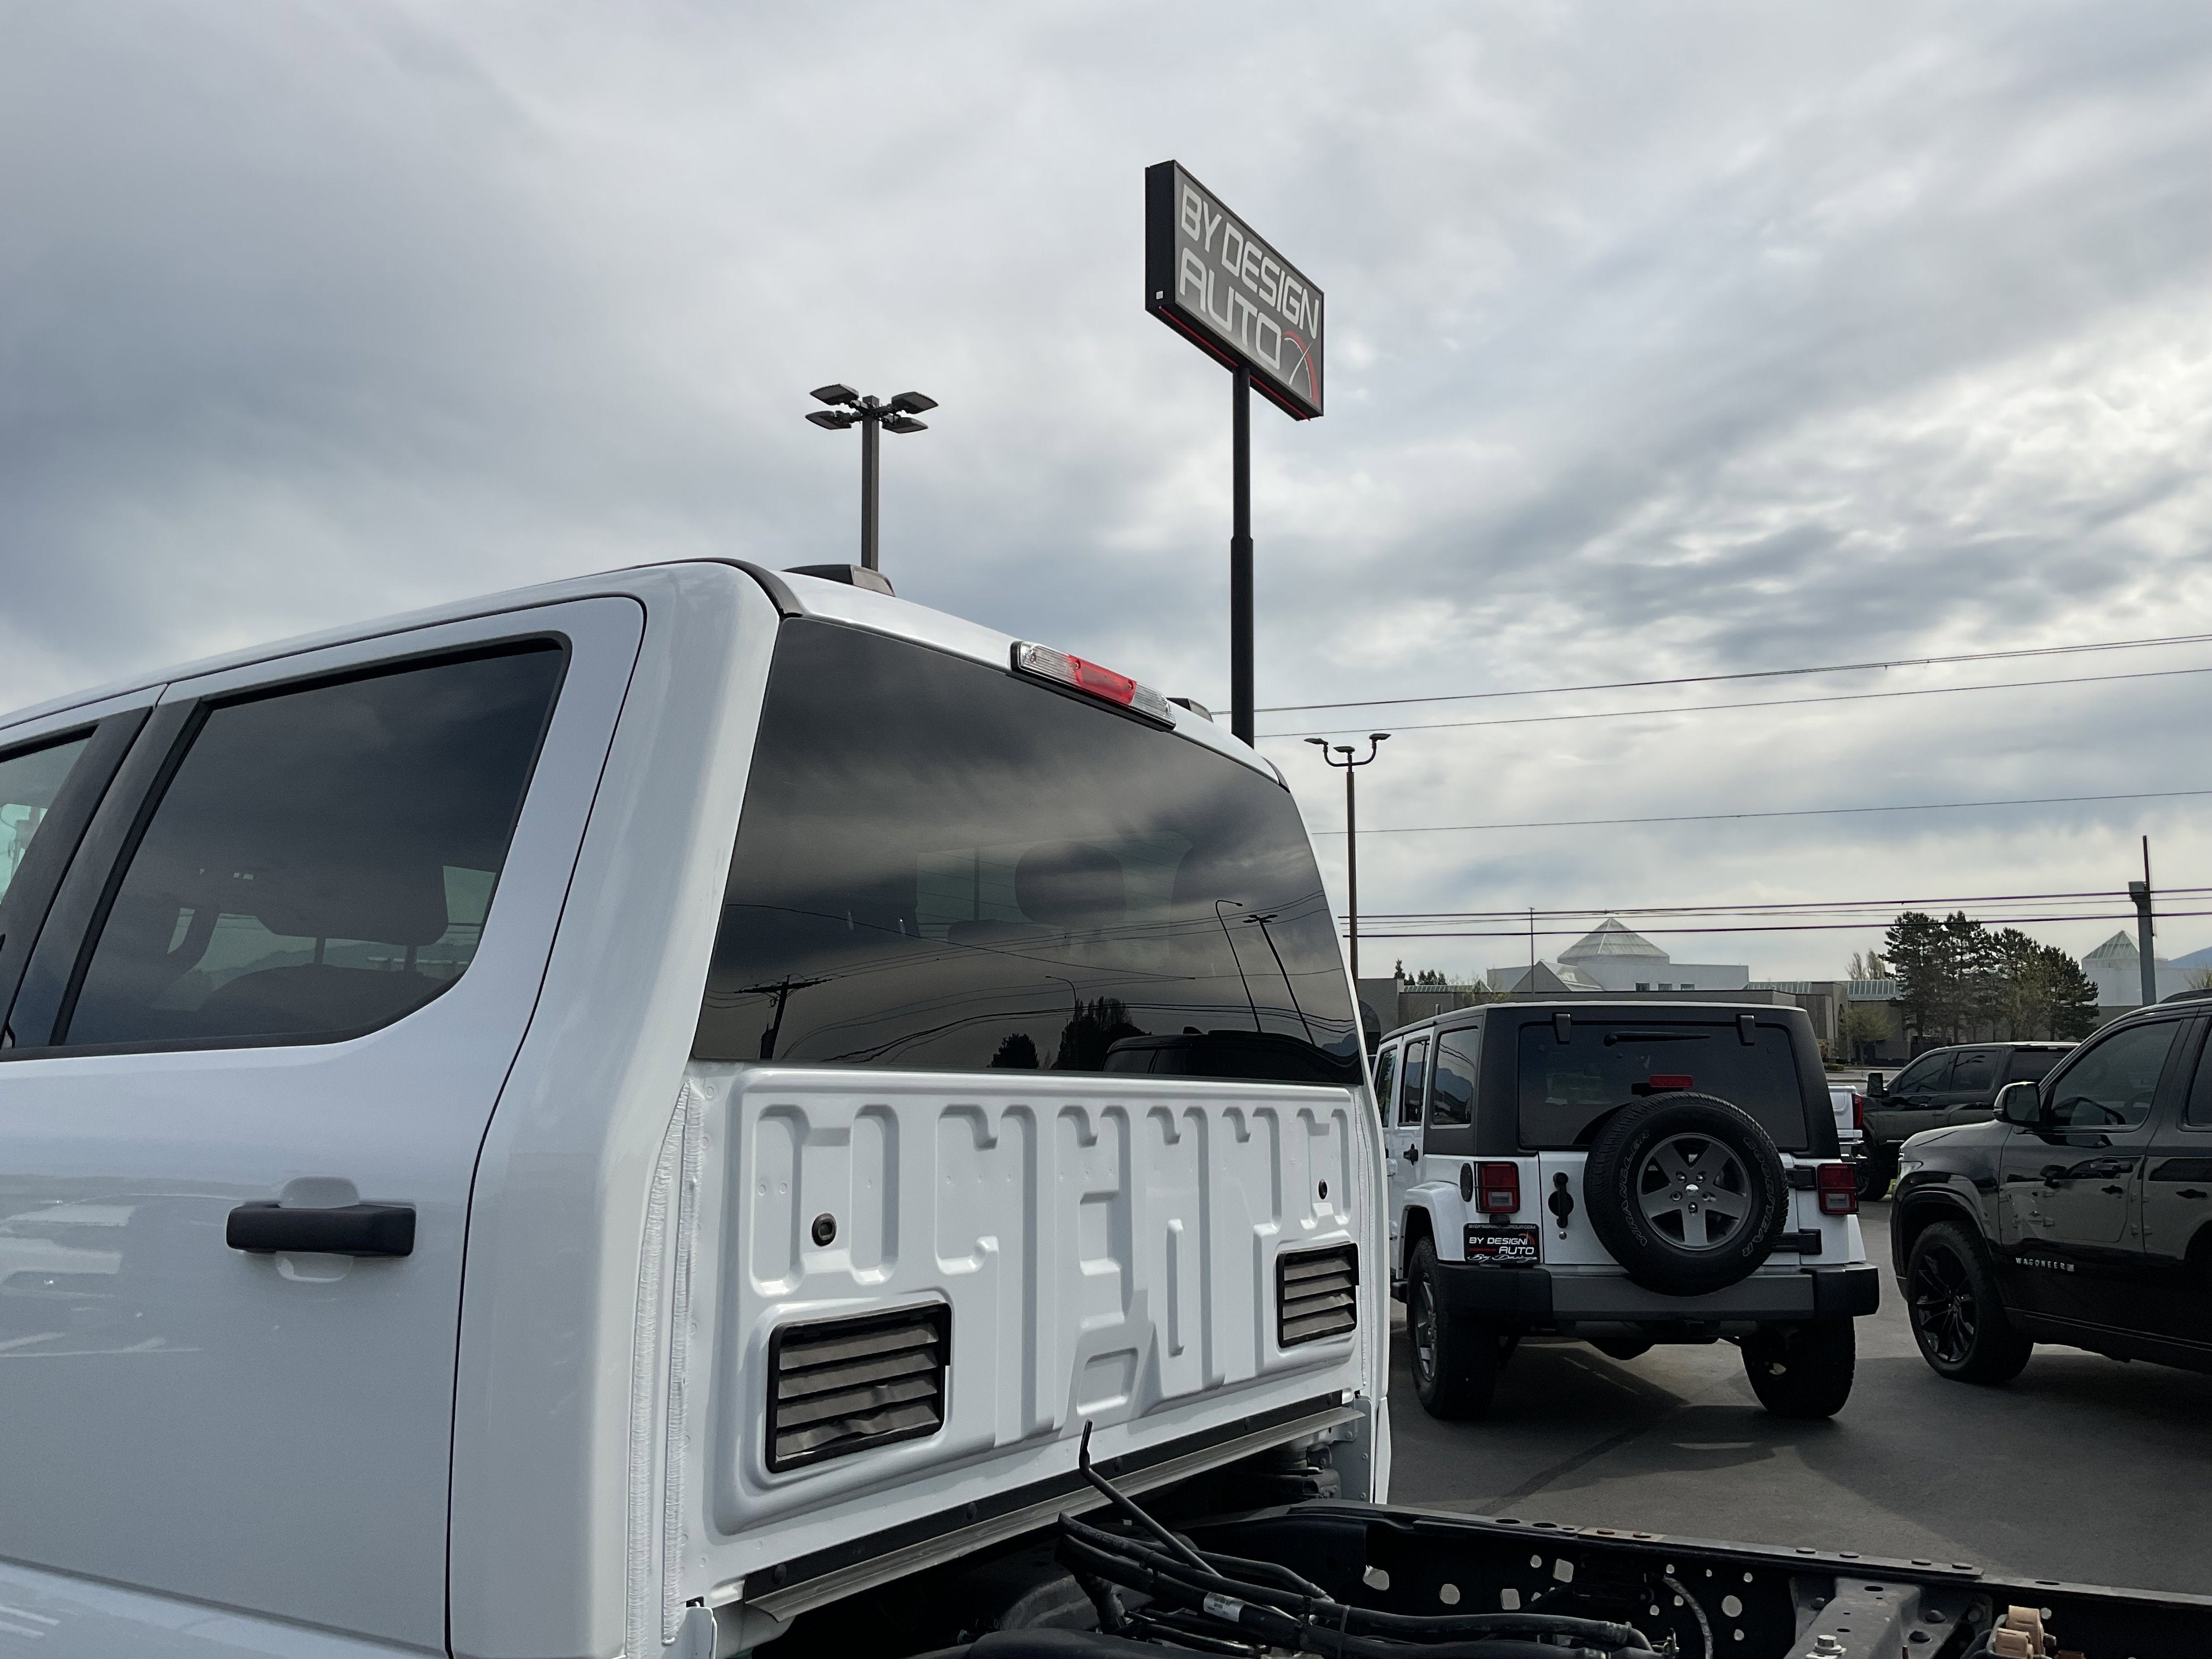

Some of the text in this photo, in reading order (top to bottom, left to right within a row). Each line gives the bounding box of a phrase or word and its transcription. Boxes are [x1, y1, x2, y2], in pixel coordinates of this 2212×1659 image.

[1179, 247, 1282, 370] AUTO
[1181, 184, 1319, 340] BY DESIGN
[1487, 1237, 1528, 1245] DESIGN
[1618, 1129, 1650, 1248] WRANGLER
[1741, 1137, 1776, 1257] GOODYEAR
[1498, 1246, 1534, 1255] AUTO
[2015, 1257, 2066, 1270] WAGONEER
